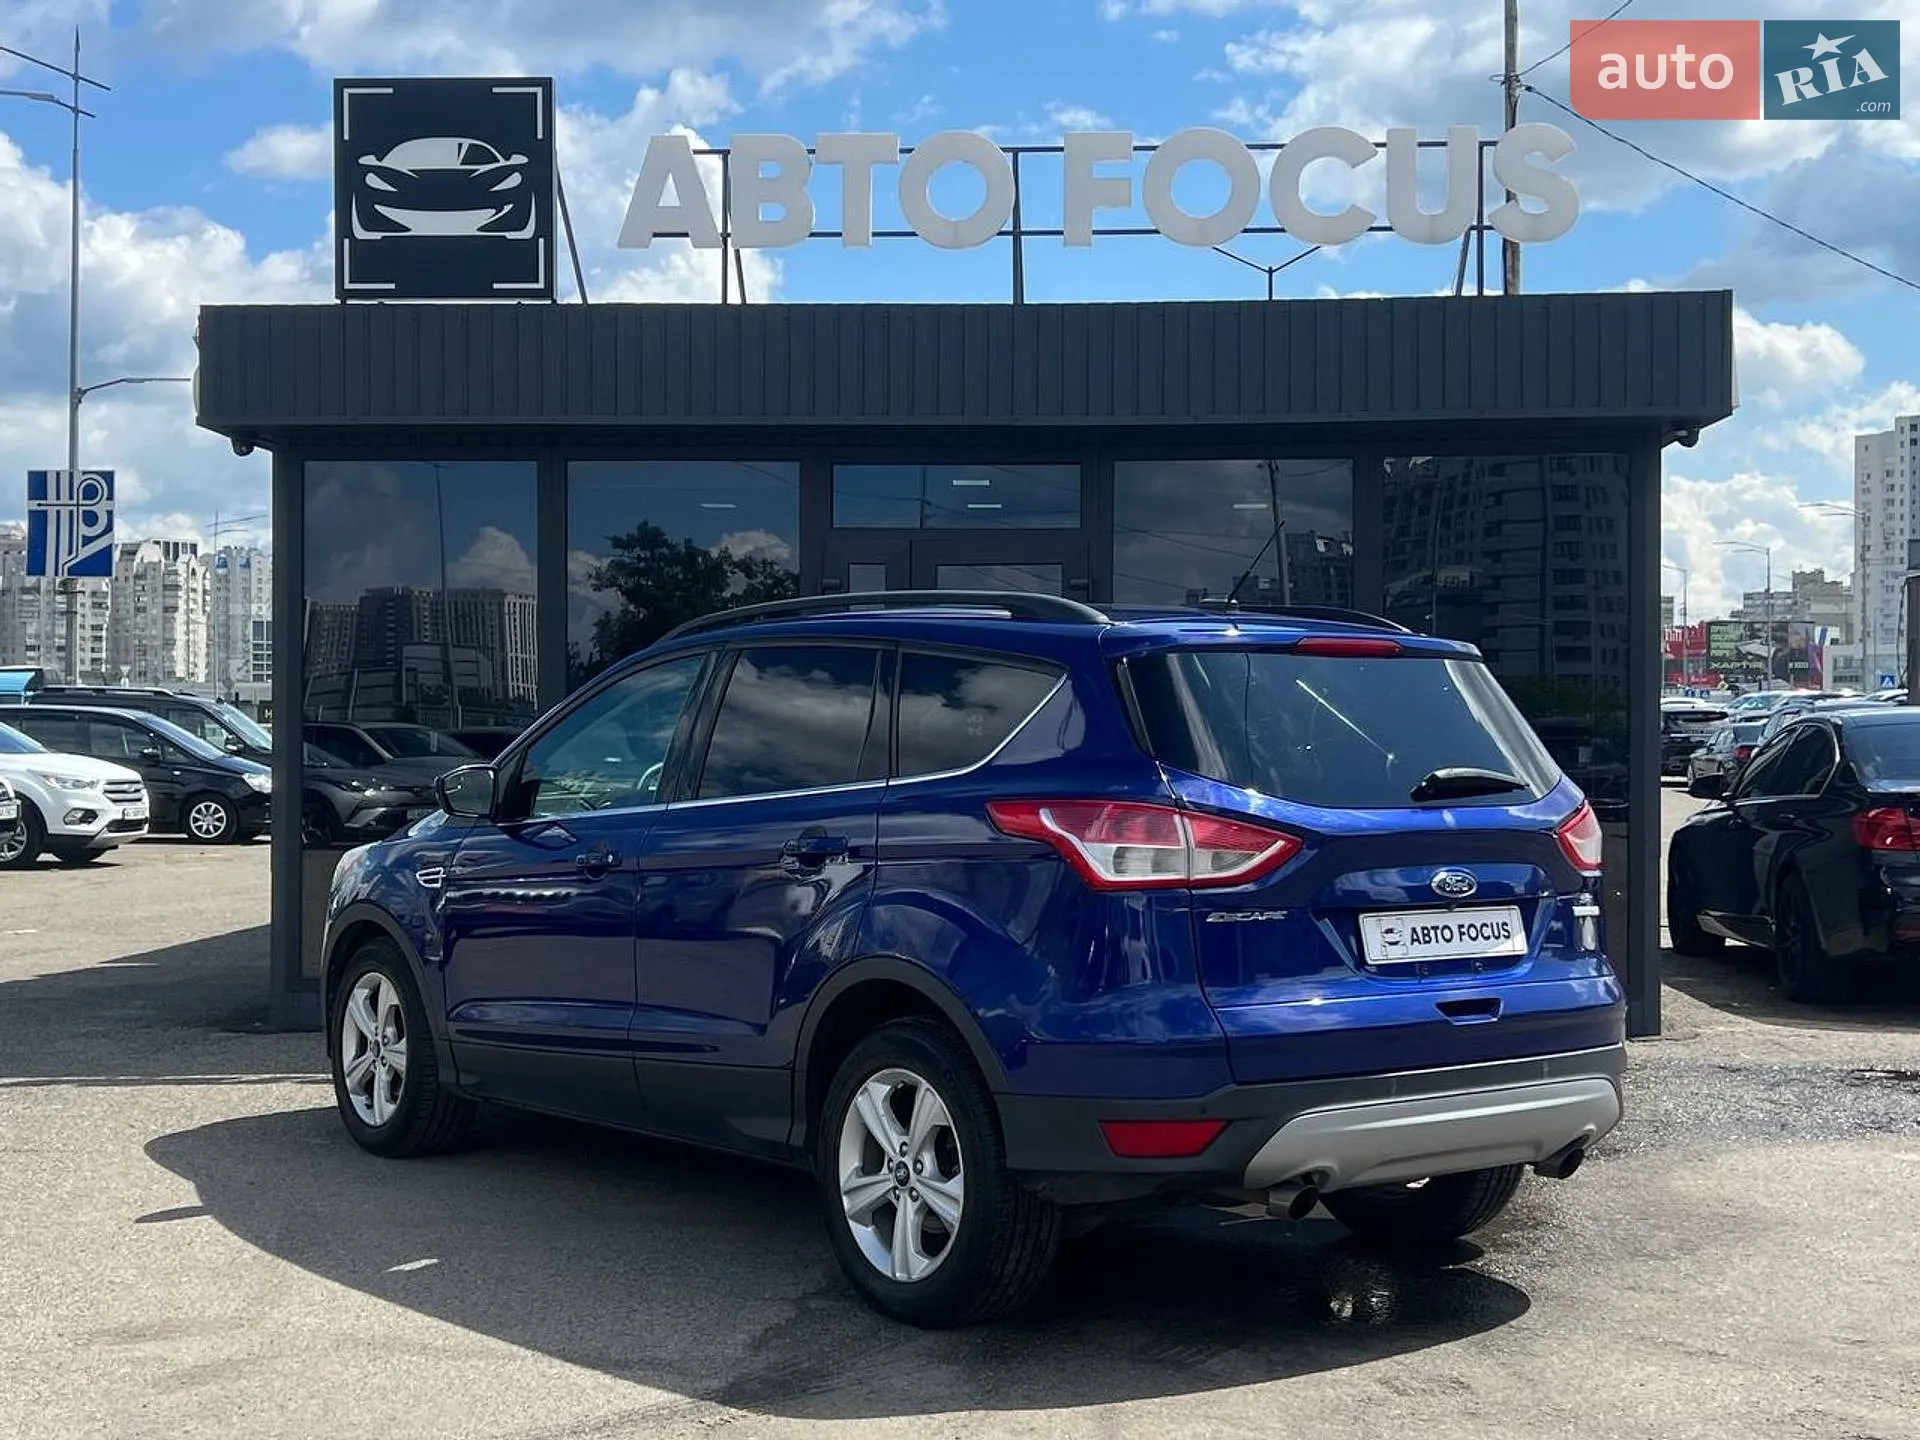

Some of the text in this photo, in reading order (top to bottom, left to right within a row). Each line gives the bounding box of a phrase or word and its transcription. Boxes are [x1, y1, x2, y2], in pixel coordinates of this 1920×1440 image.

[617, 122, 1580, 250] АВТО FOCUS
[1410, 921, 1511, 945] АВТО FOCUS
